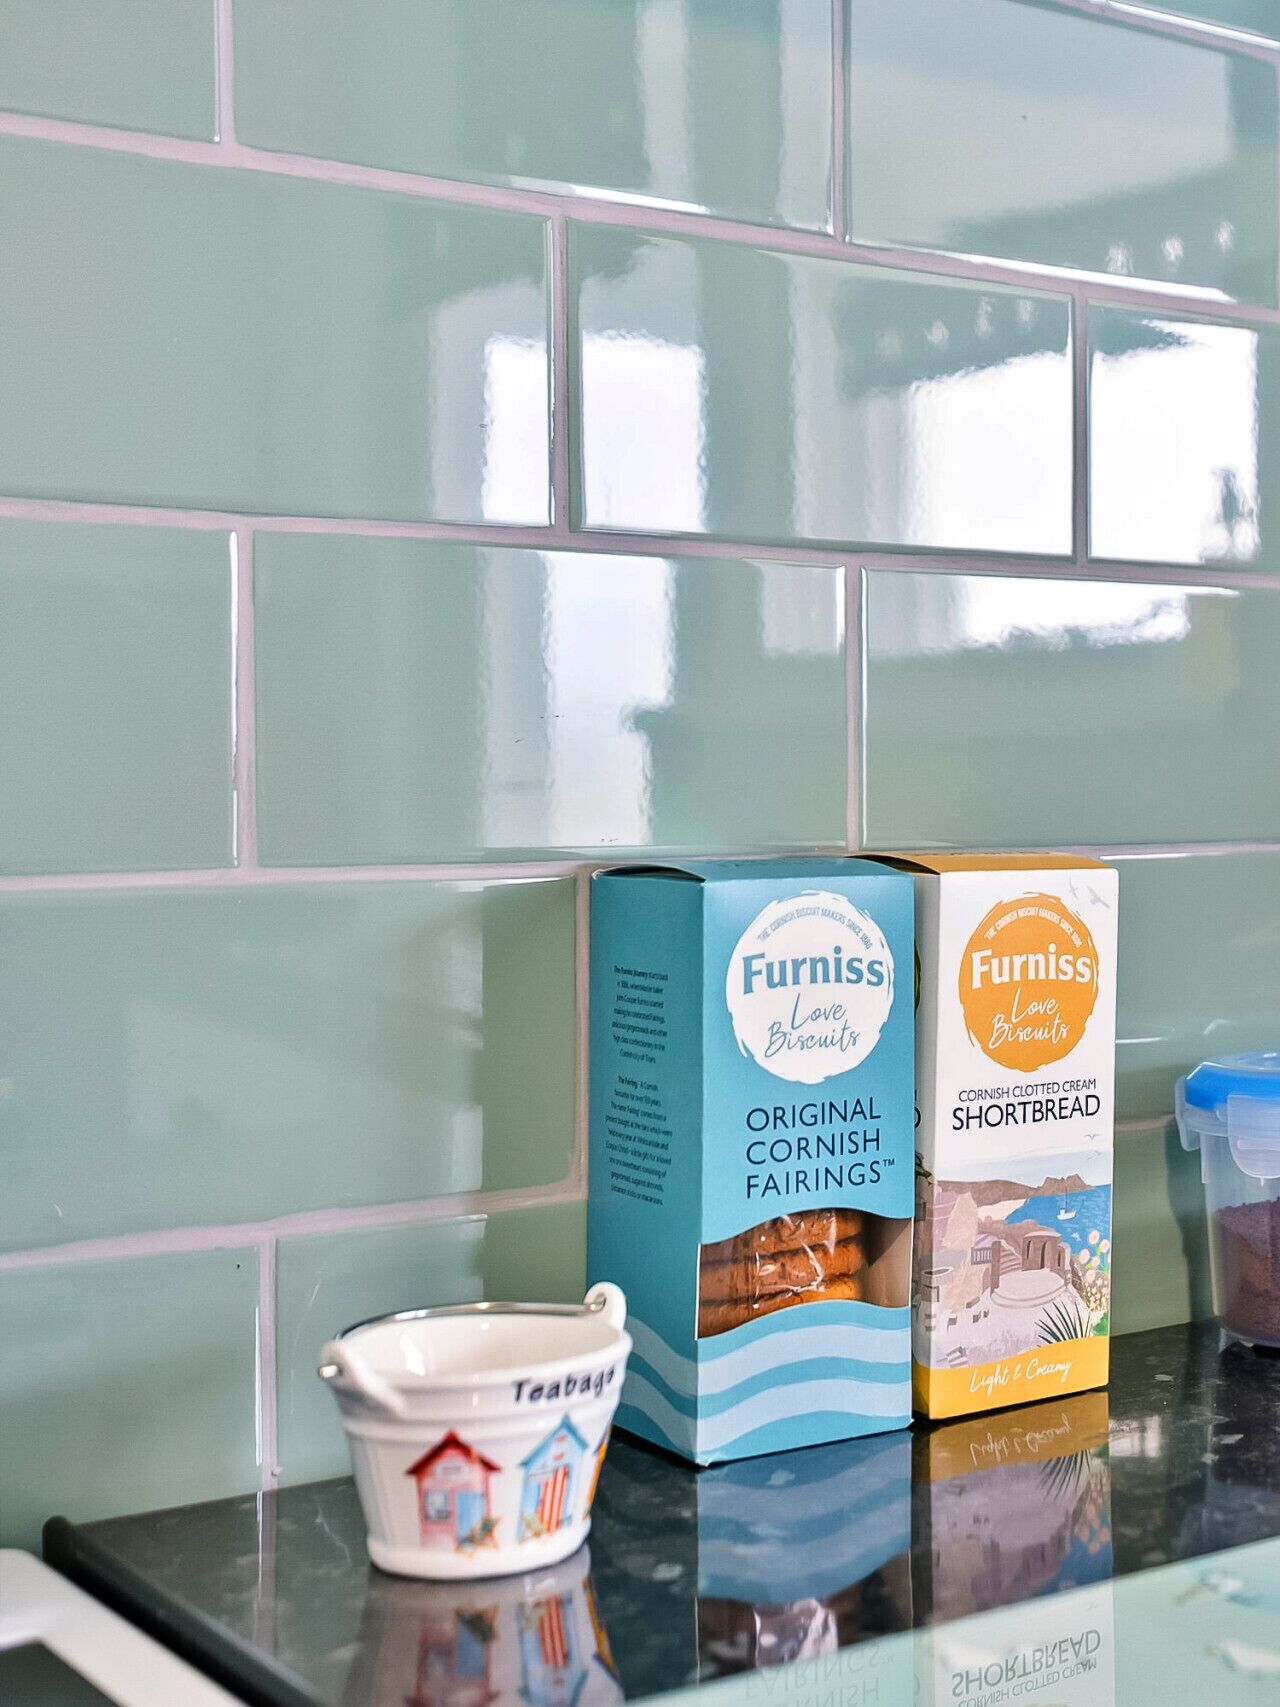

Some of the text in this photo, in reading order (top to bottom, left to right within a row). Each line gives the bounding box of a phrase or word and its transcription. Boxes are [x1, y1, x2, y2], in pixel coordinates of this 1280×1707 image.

[757, 927, 771, 941] THE
[770, 911, 797, 931] CORNISH
[796, 906, 820, 918] BISCUIT
[821, 908, 847, 925] MAKERS
[846, 919, 863, 937] SINCE
[984, 924, 997, 940] THE
[995, 909, 1018, 931] CORNISH
[1017, 906, 1040, 918] BISCUIT
[1039, 907, 1061, 925] MAKERS
[1060, 918, 1075, 937] SINCE
[742, 945, 885, 995] Furniss
[971, 943, 1092, 990] Furniss
[790, 992, 846, 1030] Love
[1011, 987, 1058, 1023] Love
[764, 1018, 861, 1058] Biscuits
[988, 1013, 1070, 1050] Biscuits
[958, 1078, 1097, 1102] CORNISH CLOTTED CREAM
[746, 1096, 882, 1131] ORIGINAL
[952, 1094, 1101, 1131] SHORTBREAD
[746, 1128, 880, 1165] CORNISH
[512, 1364, 615, 1404] Teabags
[970, 1364, 1010, 1396] Light
[1026, 1357, 1073, 1383] Creamy
